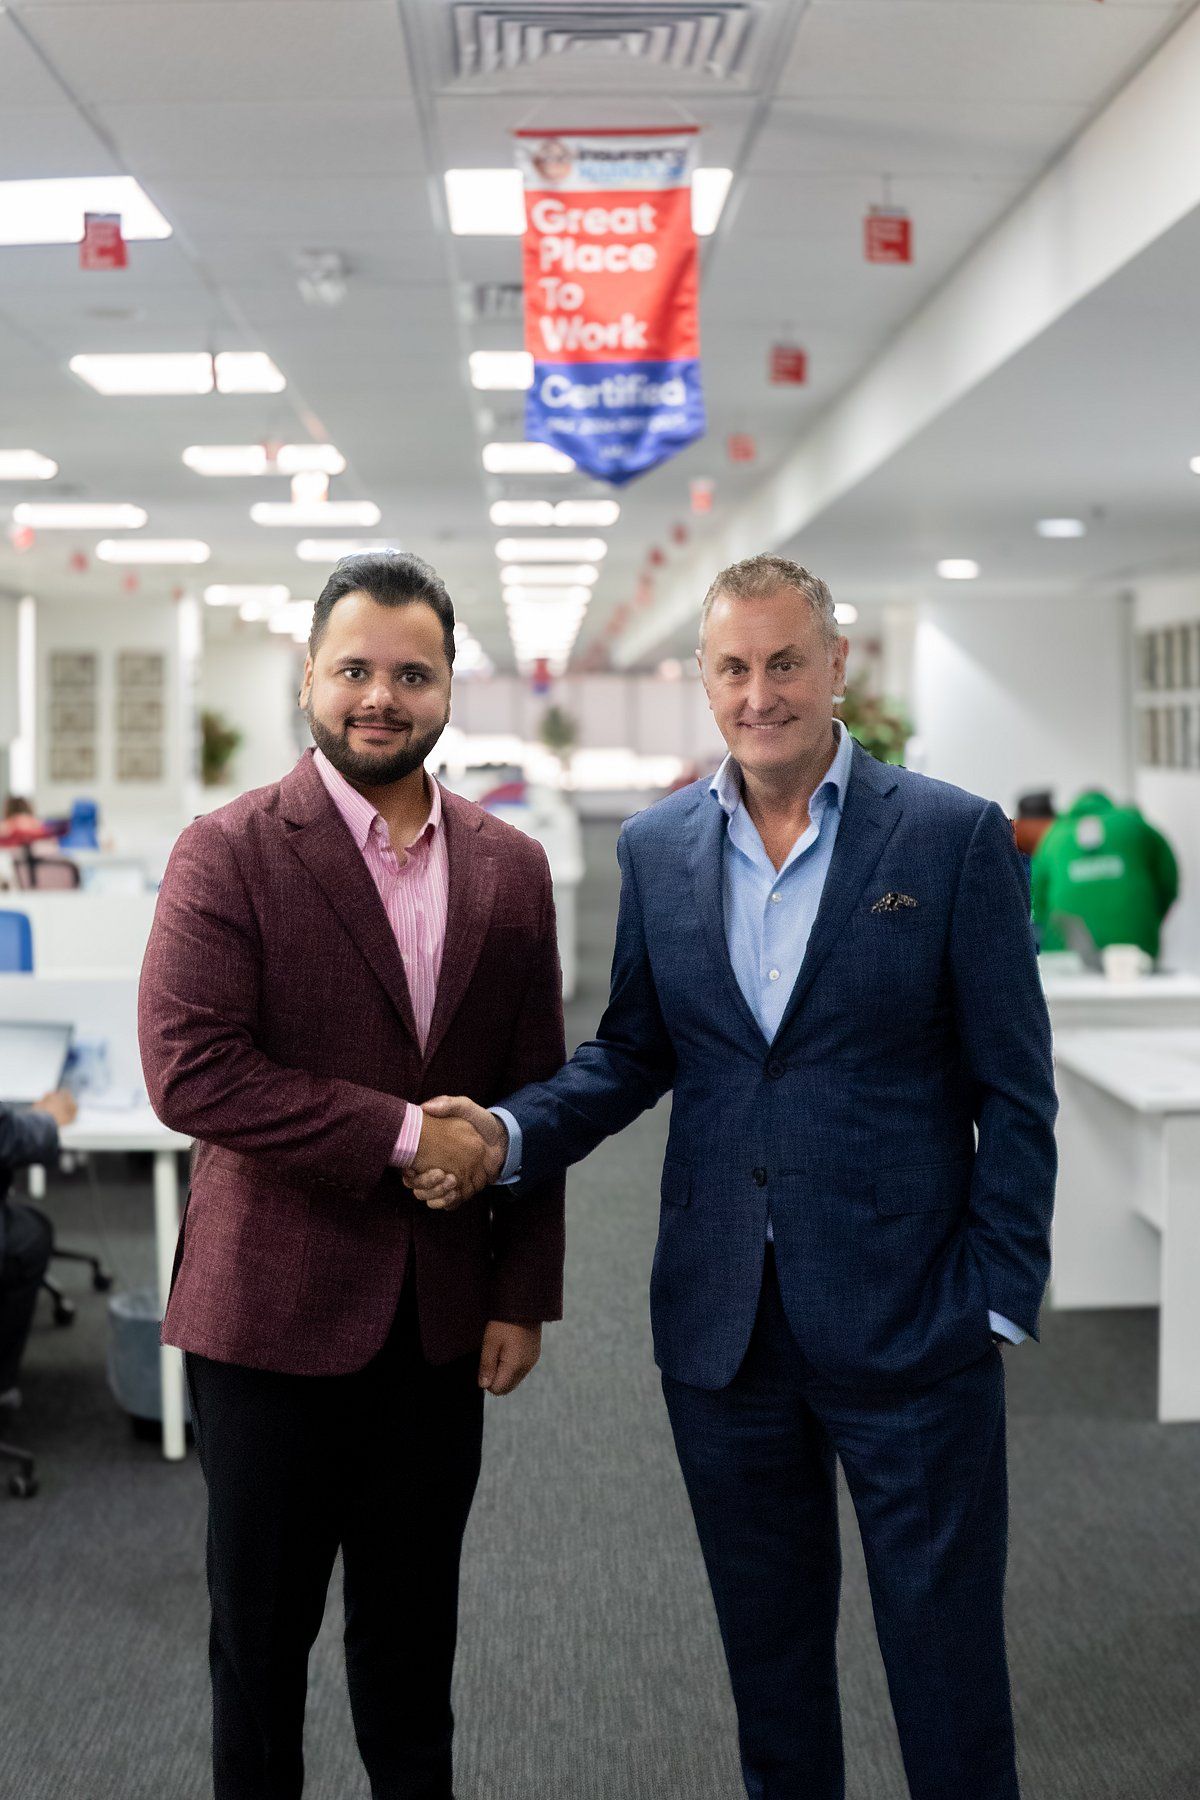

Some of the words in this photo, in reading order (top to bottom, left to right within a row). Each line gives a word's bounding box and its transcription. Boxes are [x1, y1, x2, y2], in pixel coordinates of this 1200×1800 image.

[531, 199, 656, 234] Great
[540, 236, 657, 273] Place
[539, 277, 584, 311] To
[540, 313, 649, 353] Work
